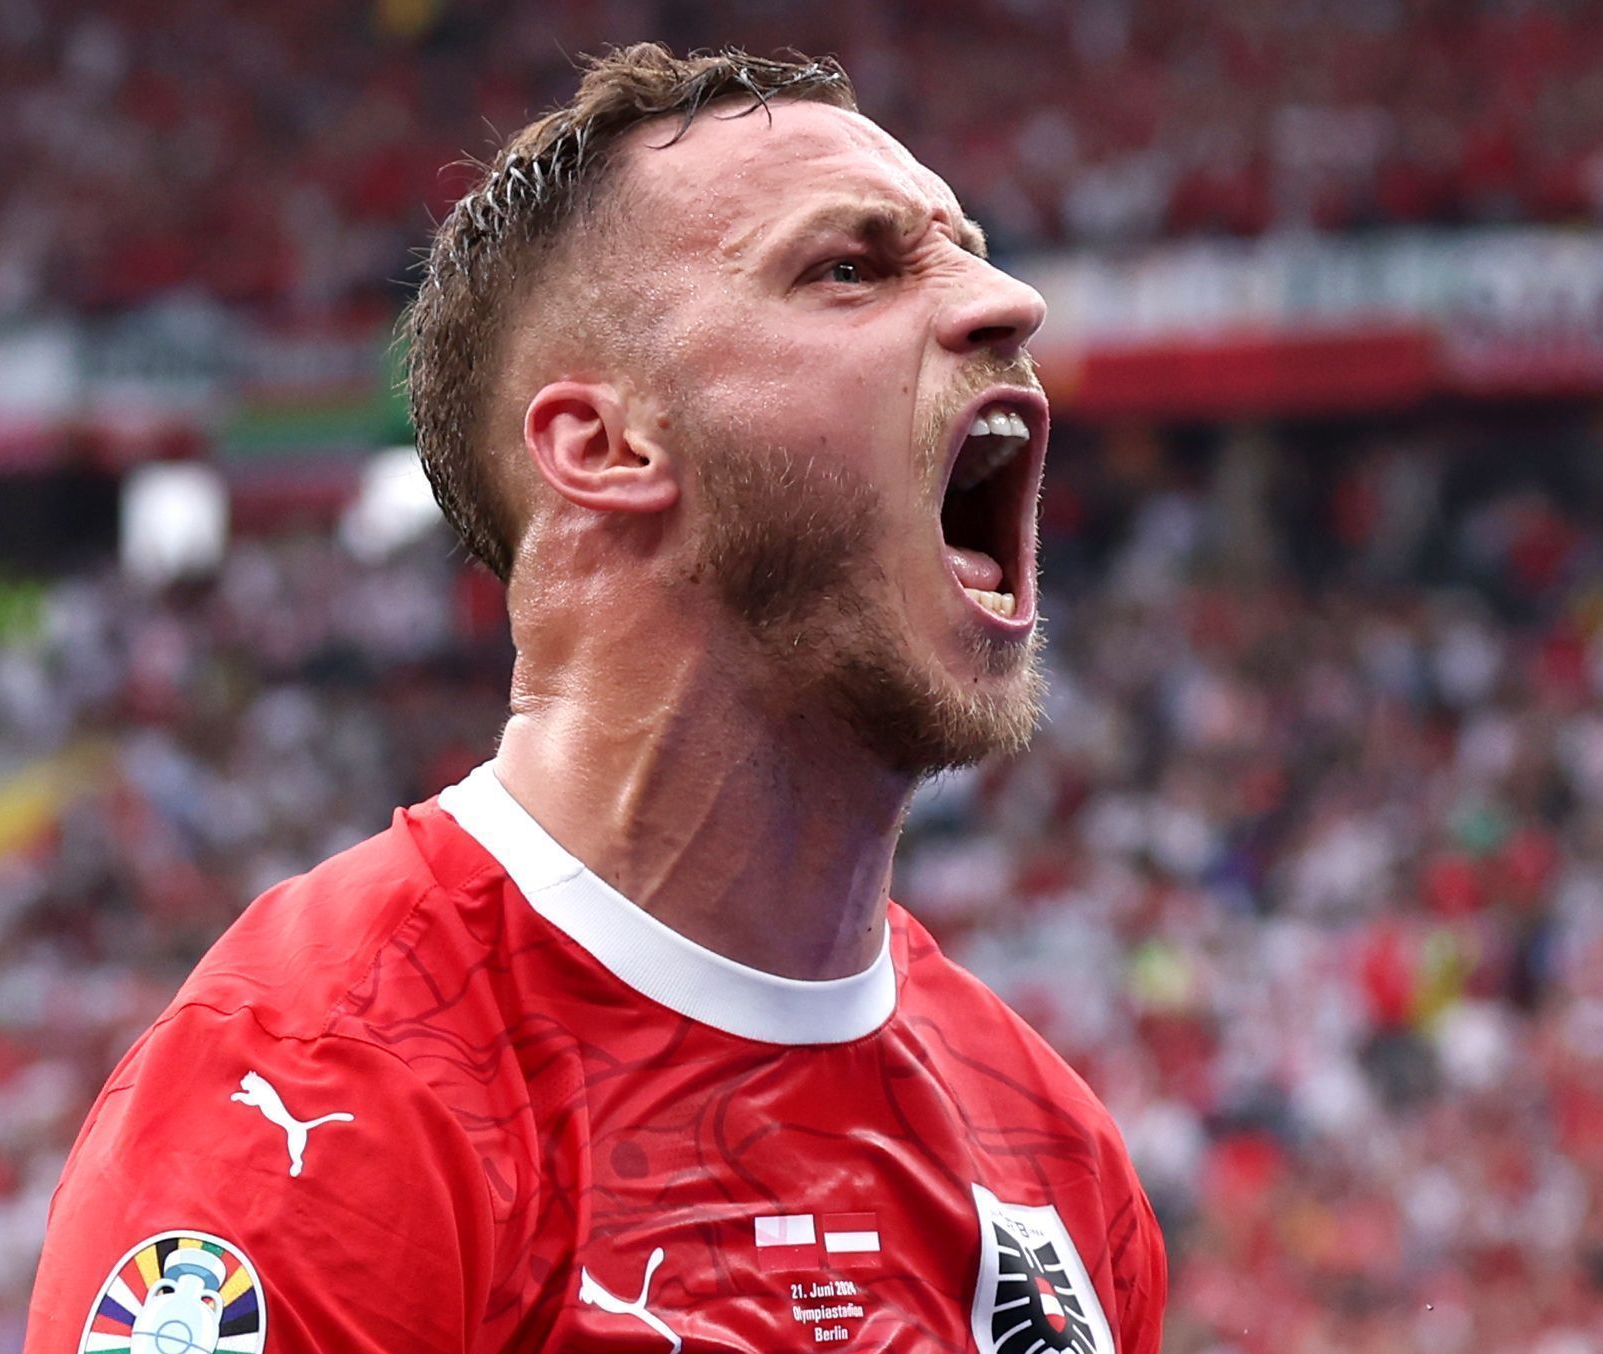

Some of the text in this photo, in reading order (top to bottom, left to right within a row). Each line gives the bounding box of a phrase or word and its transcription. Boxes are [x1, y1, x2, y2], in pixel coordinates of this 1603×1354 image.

[790, 1283, 808, 1300] 21.
[809, 1281, 834, 1298] Juni
[792, 1302, 864, 1325] Olympiastadion
[814, 1326, 849, 1343] Berlin
